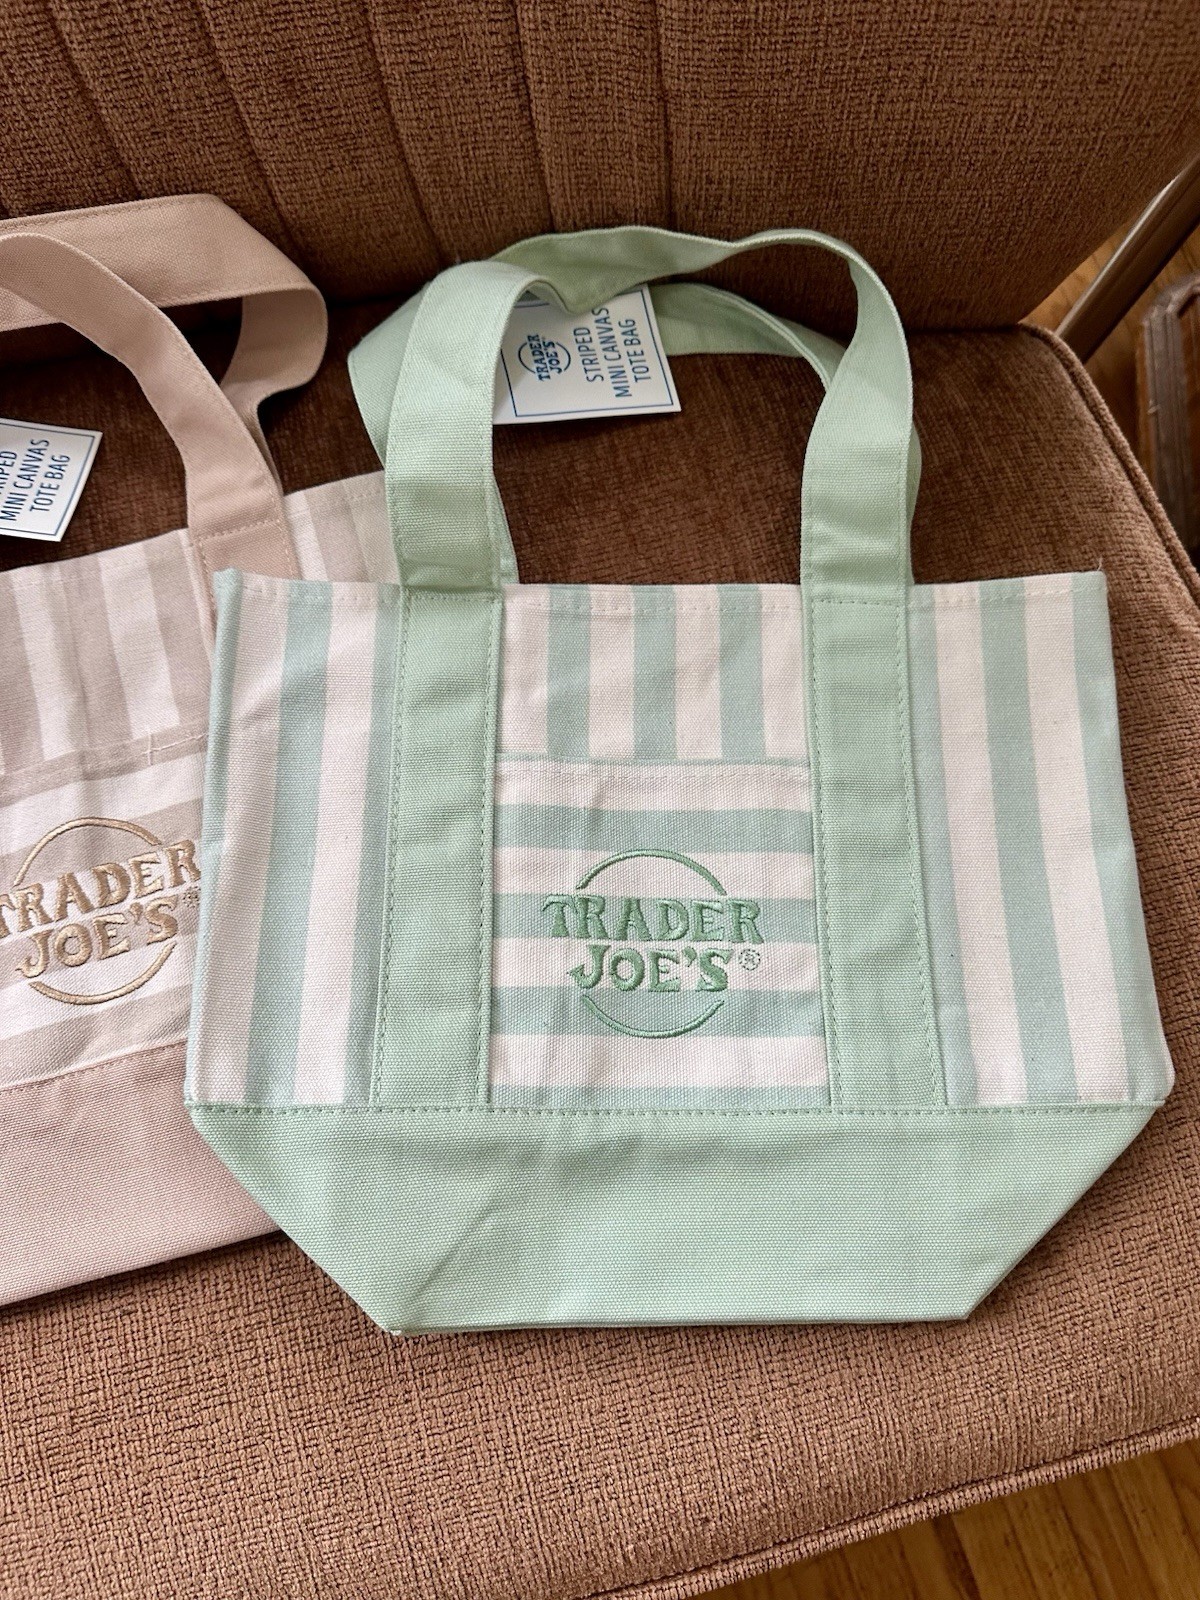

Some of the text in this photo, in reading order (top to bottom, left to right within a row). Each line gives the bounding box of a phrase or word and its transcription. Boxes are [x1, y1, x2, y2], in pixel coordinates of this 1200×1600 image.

[527, 334, 551, 381] TRADER
[542, 341, 562, 374] JOE'S
[573, 327, 604, 382] STRIPED
[592, 307, 632, 398] MINI CANVAS
[618, 318, 651, 383] TOTE BAG
[0, 439, 50, 521] MINI CANVAS
[29, 455, 71, 512] TOTE BAG
[542, 894, 764, 944] TRADER
